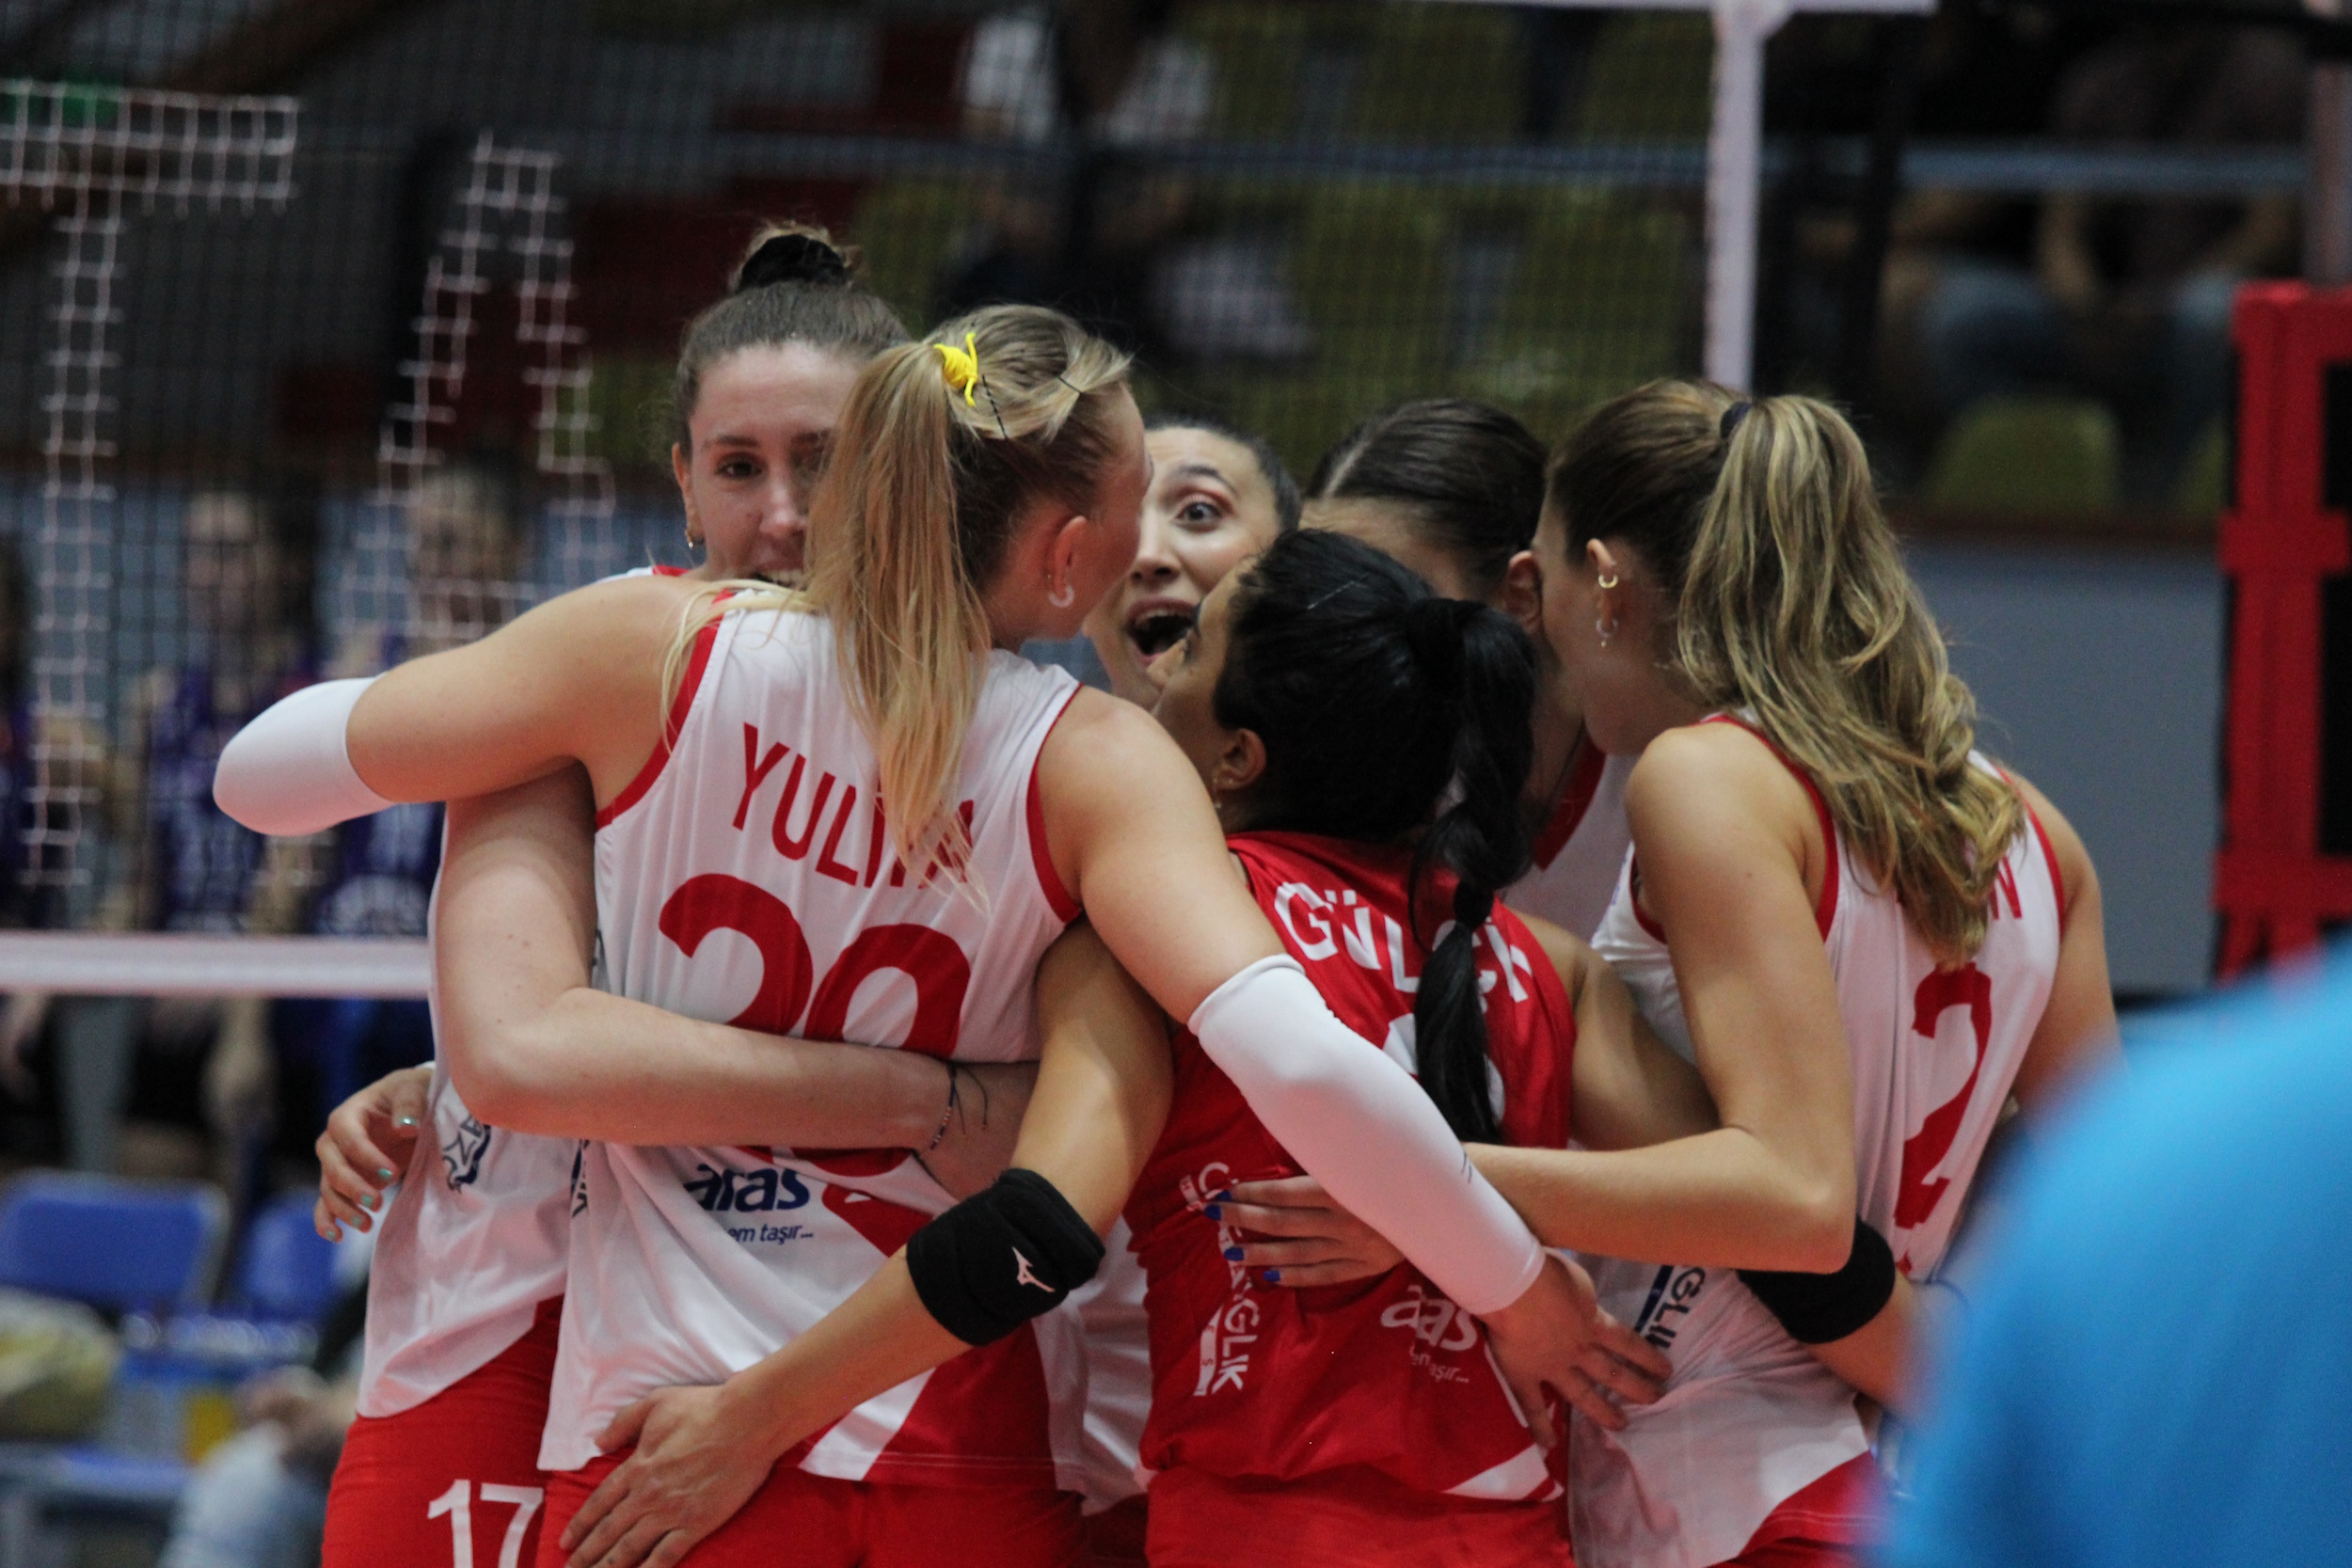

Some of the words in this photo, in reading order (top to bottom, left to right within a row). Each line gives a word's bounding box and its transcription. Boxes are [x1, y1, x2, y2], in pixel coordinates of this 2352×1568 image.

[1894, 961, 1993, 1229] 2
[683, 1164, 810, 1212] aras
[427, 1479, 545, 1568] 17
